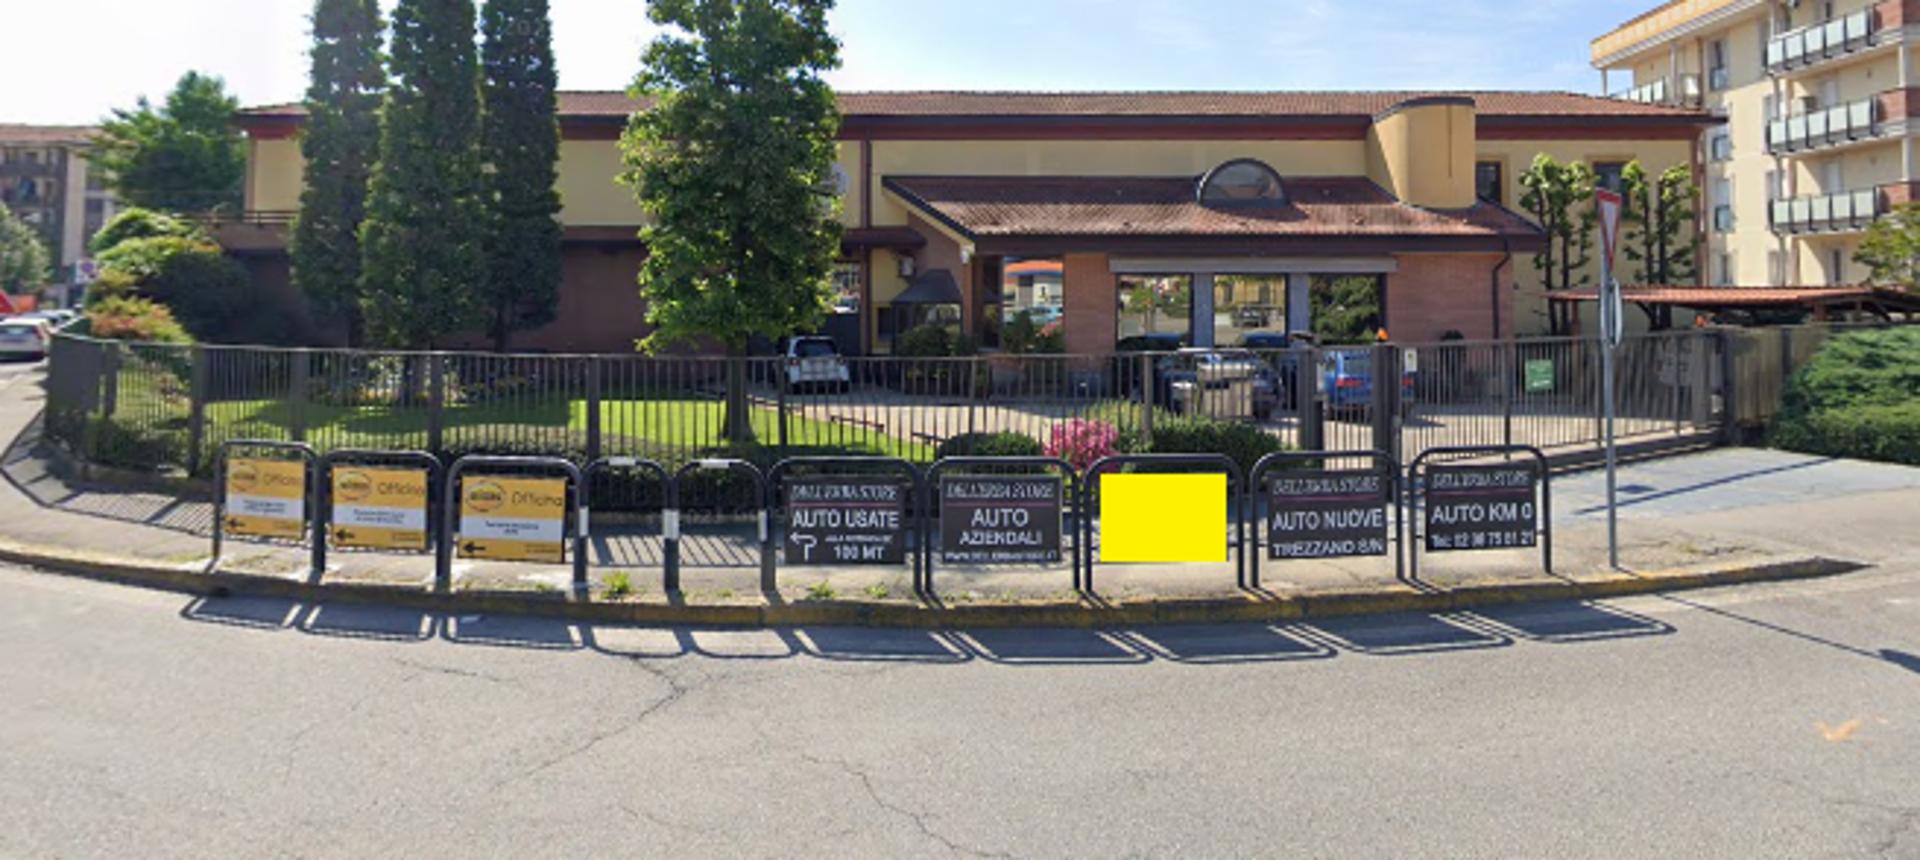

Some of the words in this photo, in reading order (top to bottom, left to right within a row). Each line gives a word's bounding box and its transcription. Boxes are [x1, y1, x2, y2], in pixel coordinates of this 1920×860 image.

[511, 490, 563, 508] Officina
[792, 508, 841, 528] AUTO
[844, 508, 899, 529] USATE
[971, 508, 1029, 528] AUTO
[1272, 511, 1321, 531] AUTO
[1323, 508, 1383, 529] NUOVE
[1430, 504, 1485, 525] AUTO
[1489, 502, 1518, 522] KM
[1522, 501, 1533, 520] 0
[959, 531, 1043, 546] AZIENDALI
[834, 545, 859, 560] 100
[862, 545, 885, 560] MT
[1272, 541, 1355, 557] TREZZANO
